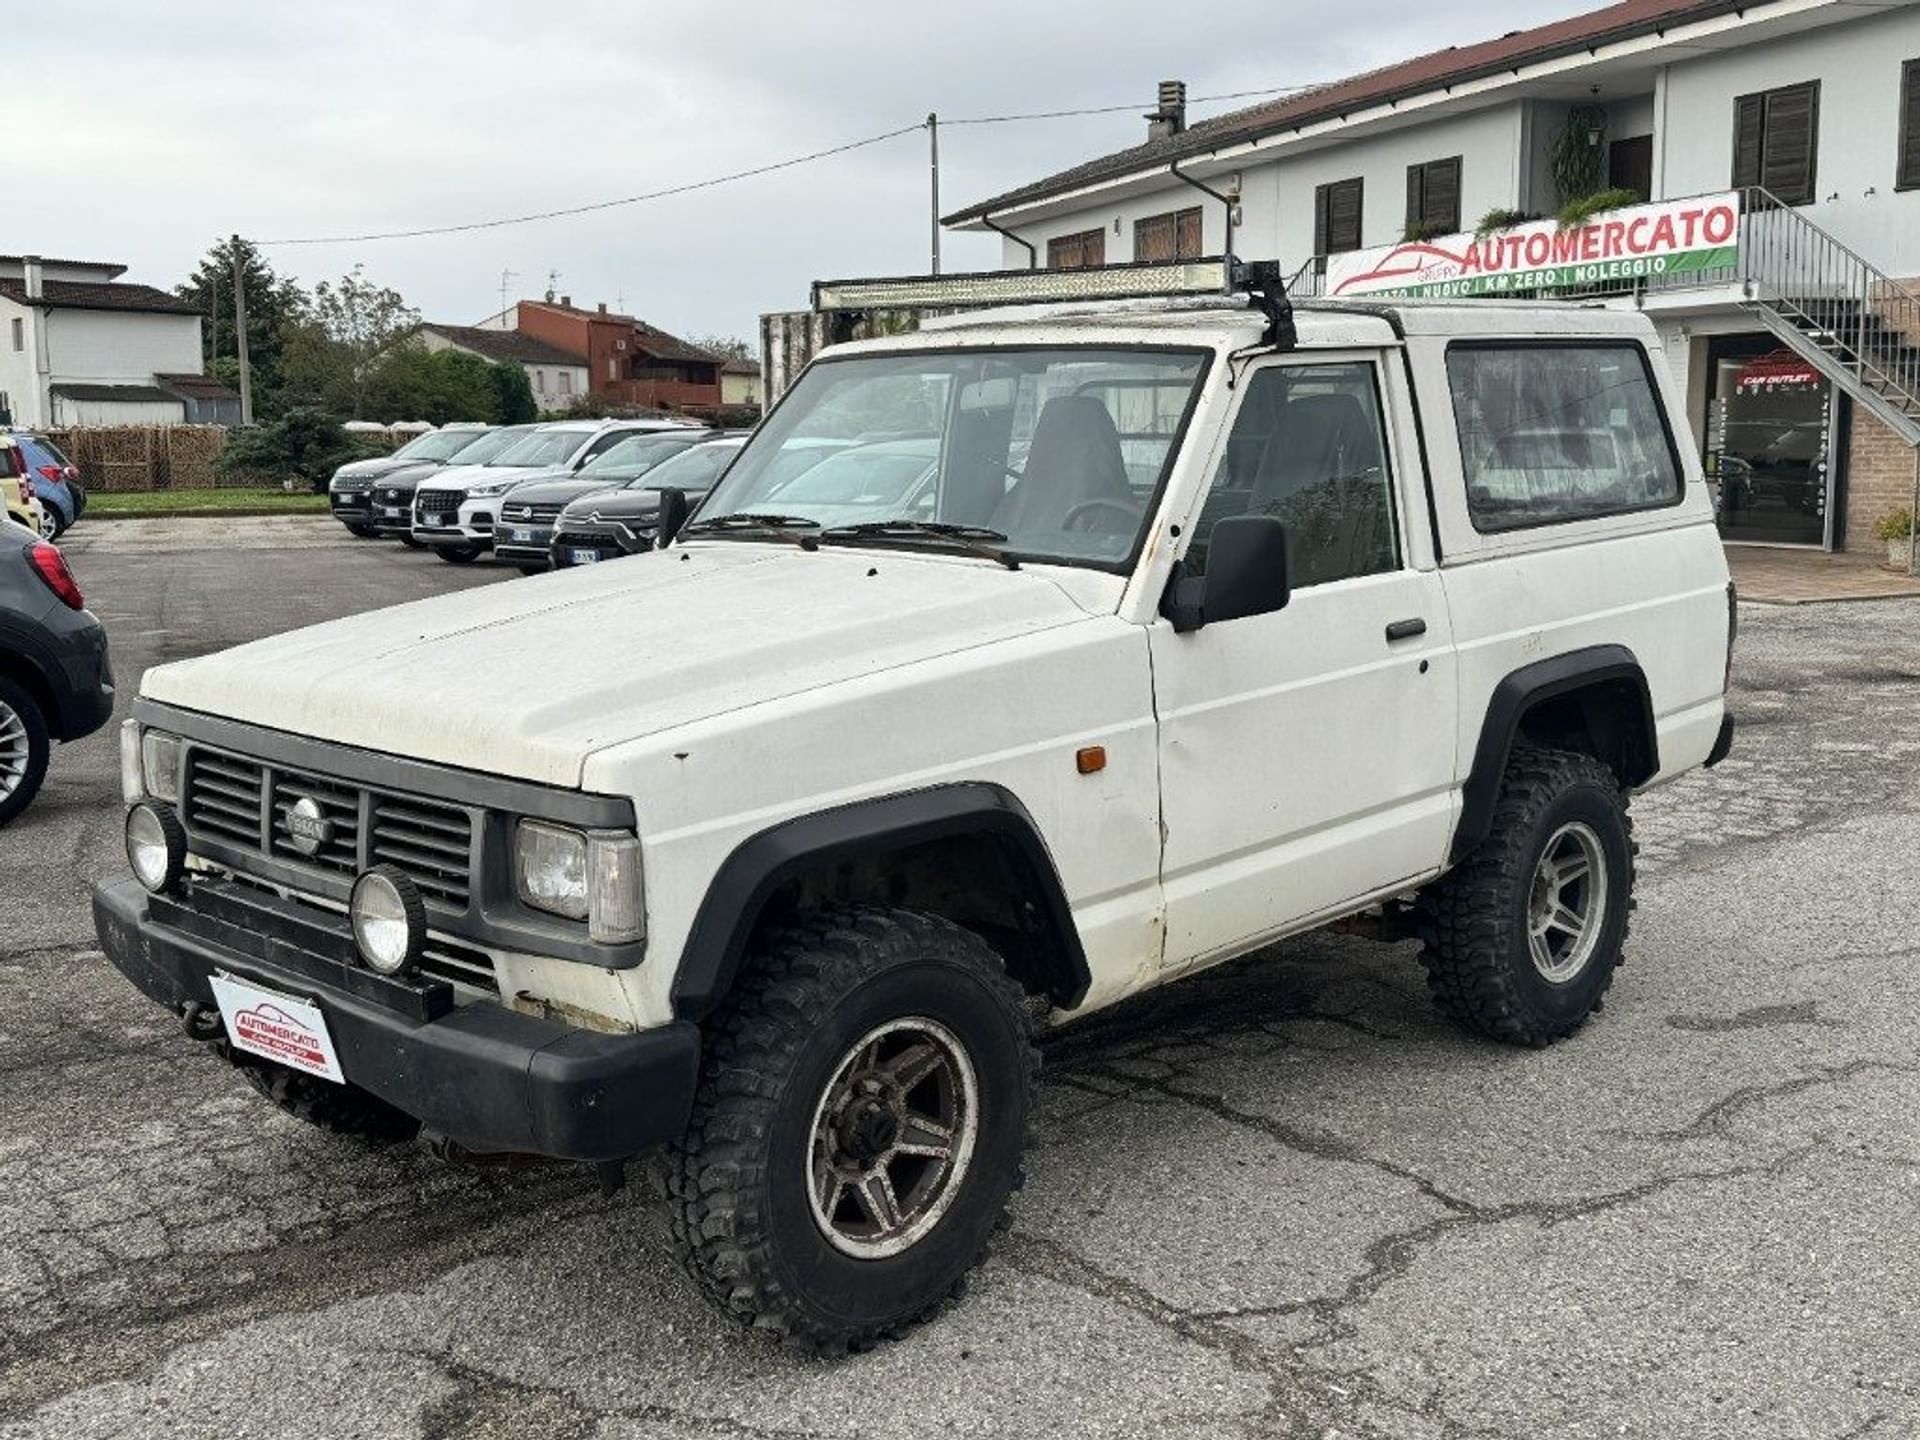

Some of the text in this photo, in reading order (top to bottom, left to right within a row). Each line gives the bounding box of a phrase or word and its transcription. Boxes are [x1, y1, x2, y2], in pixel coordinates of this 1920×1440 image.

[1459, 206, 1735, 275] AUTOMERCATO
[1418, 264, 1457, 282] GRUPPO
[1422, 280, 1470, 298] NUOVO
[1485, 275, 1508, 291] KM
[1514, 269, 1556, 289] ZERO
[1575, 256, 1667, 283] NOLEGGIO
[1743, 373, 1811, 385] CAR OUTLET
[240, 1015, 319, 1049] AUTOMERCATO
